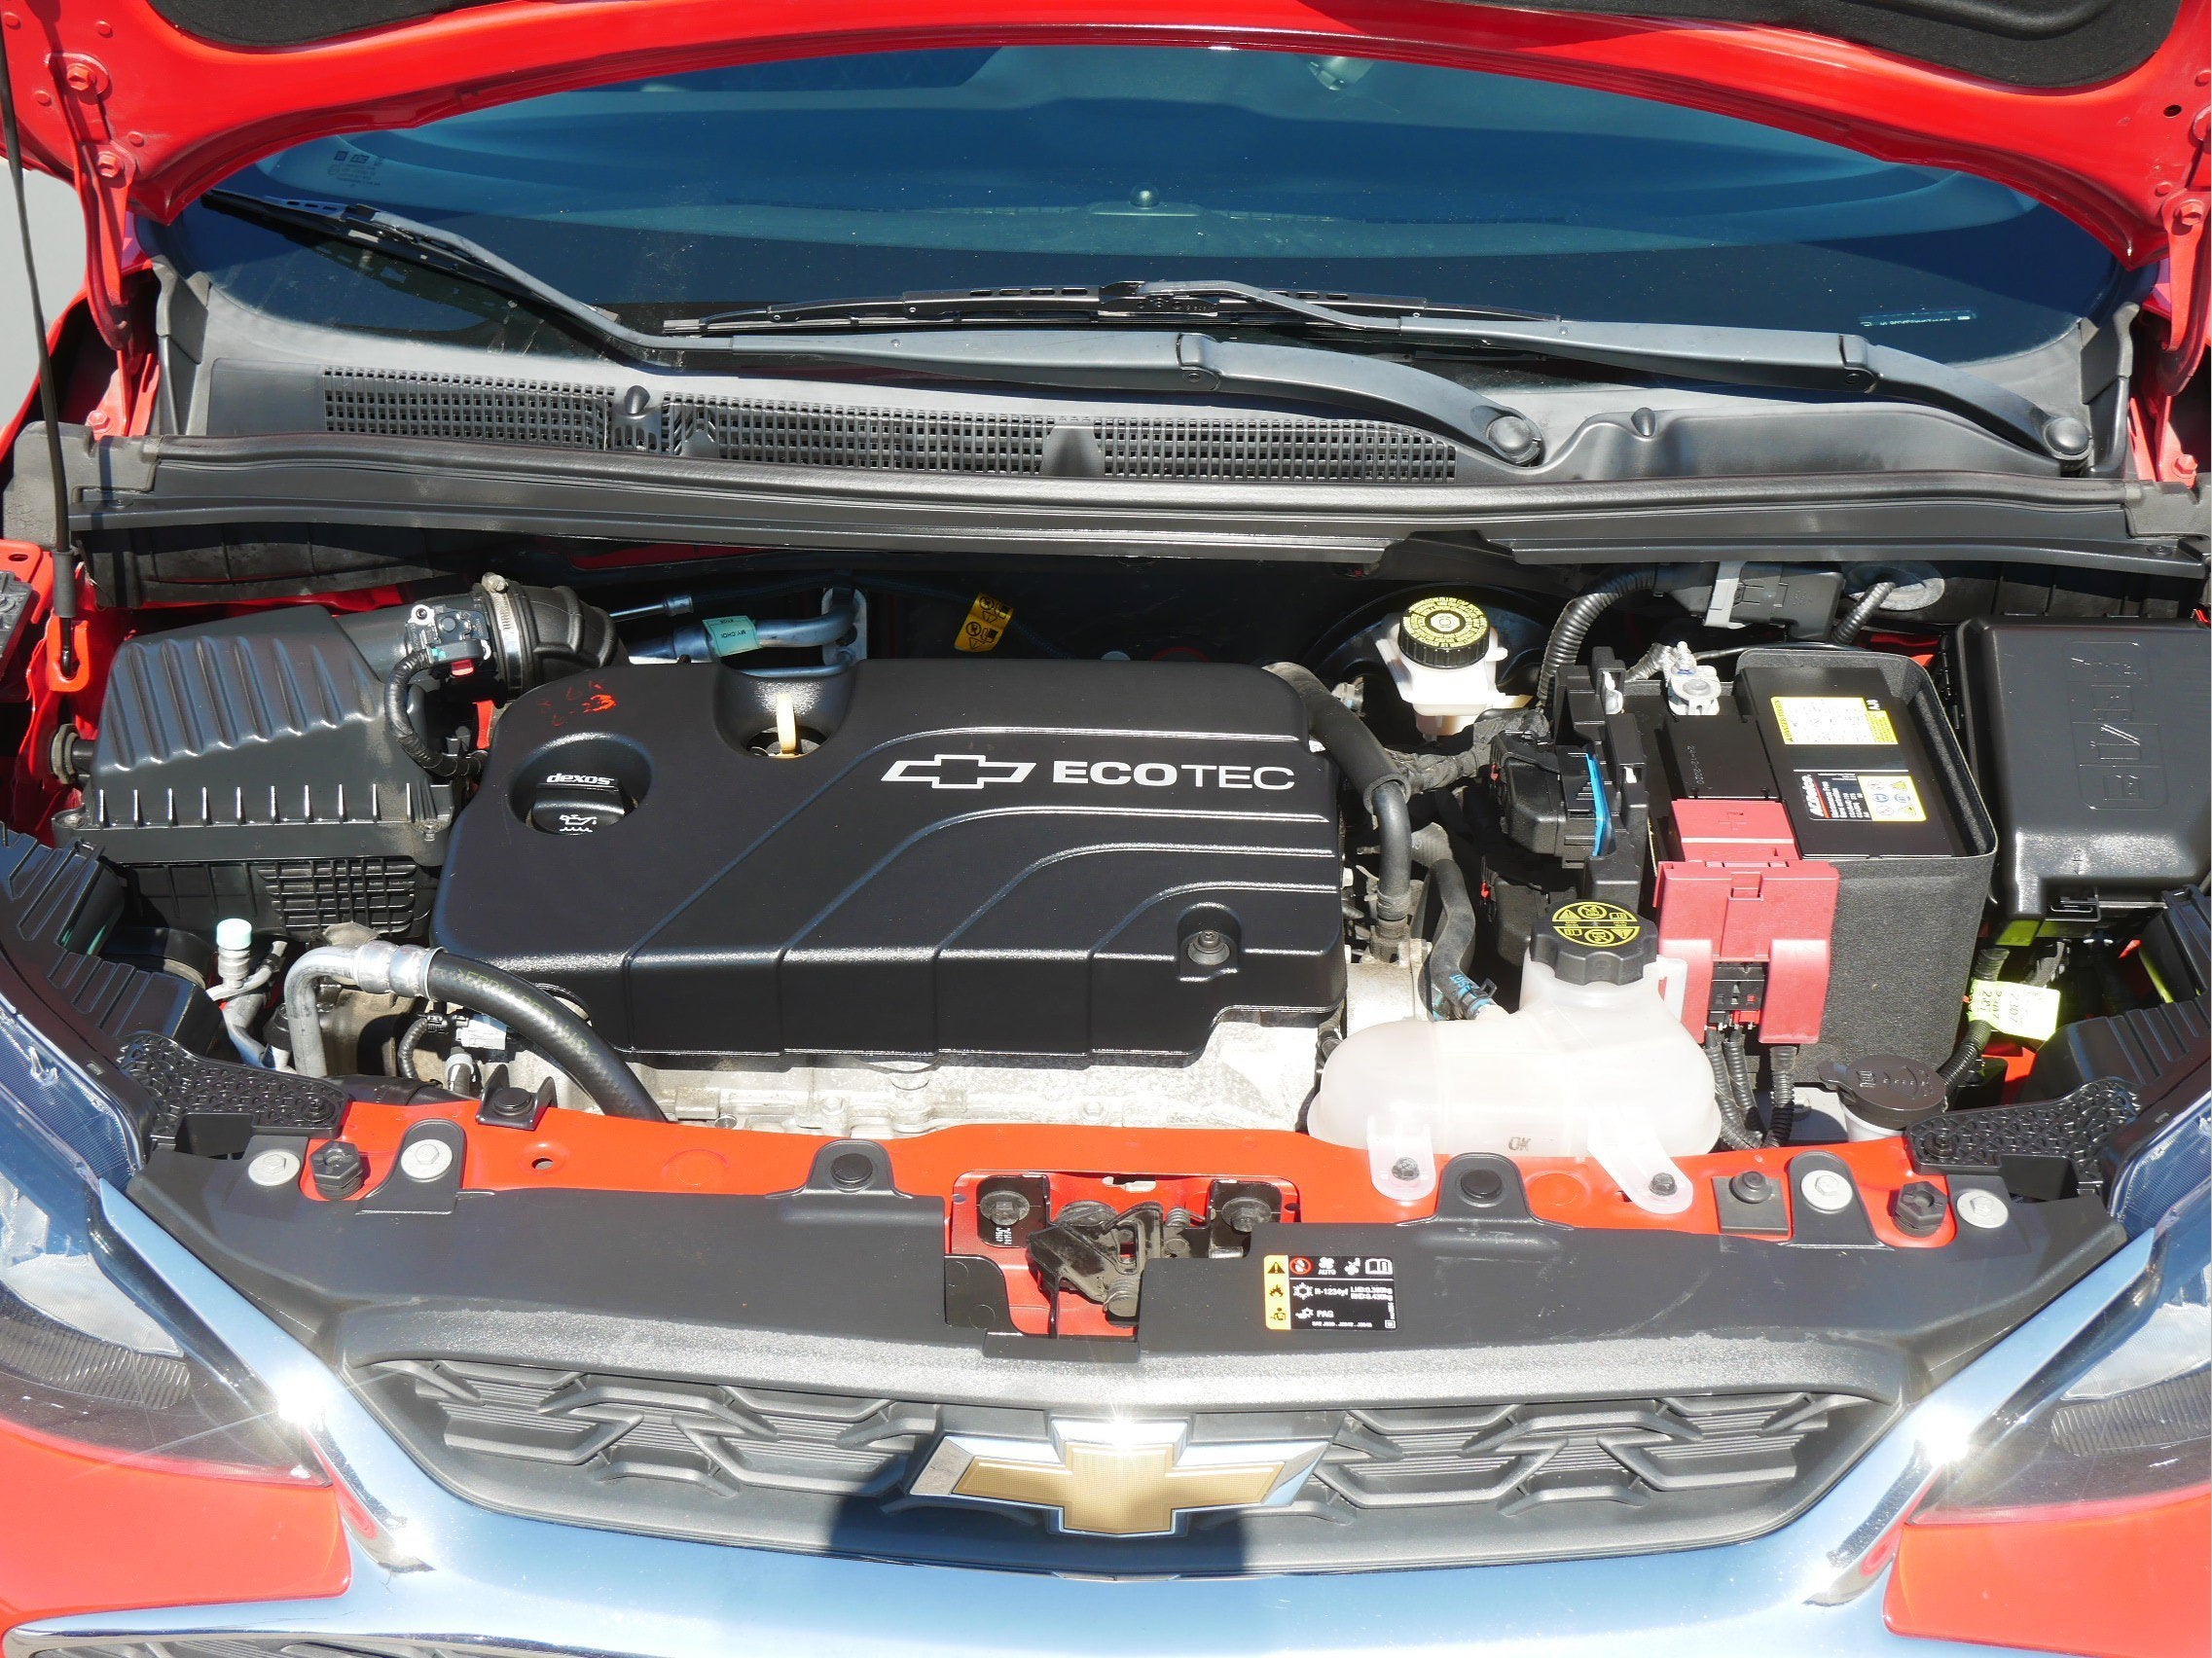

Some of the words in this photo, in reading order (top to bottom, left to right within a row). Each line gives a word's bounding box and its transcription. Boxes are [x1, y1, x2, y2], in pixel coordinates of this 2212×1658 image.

[546, 773, 615, 785] dexos
[1053, 760, 1295, 790] ECOTEC
[1508, 1136, 1532, 1151] OK
[1316, 1310, 1334, 1318] PAG
